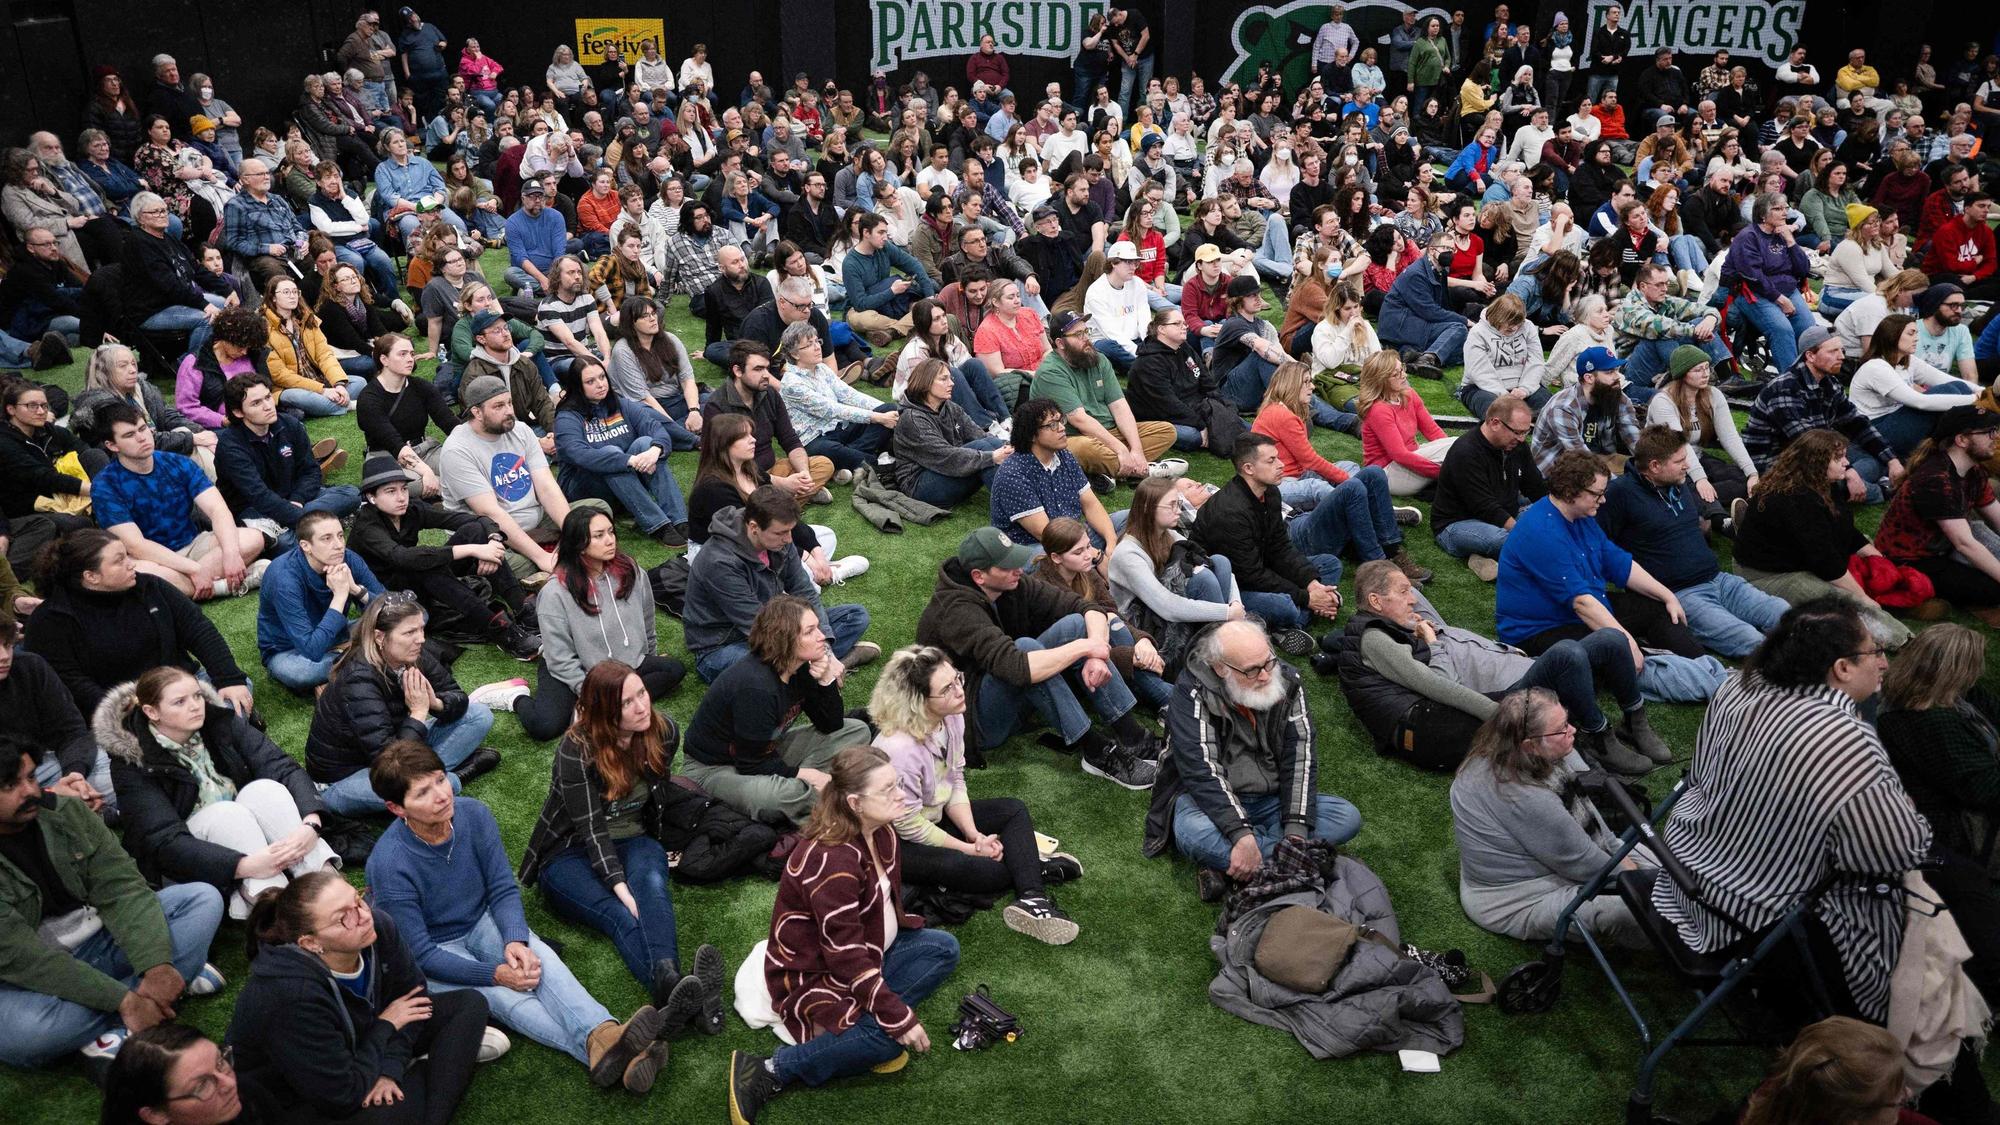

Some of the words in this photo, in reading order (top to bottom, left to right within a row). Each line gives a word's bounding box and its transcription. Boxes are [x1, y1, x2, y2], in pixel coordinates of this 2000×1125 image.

[1586, 4, 1800, 62] ANGERS
[581, 33, 660, 55] fetivl
[586, 424, 629, 443] VERMONT
[494, 466, 530, 487] NASA
